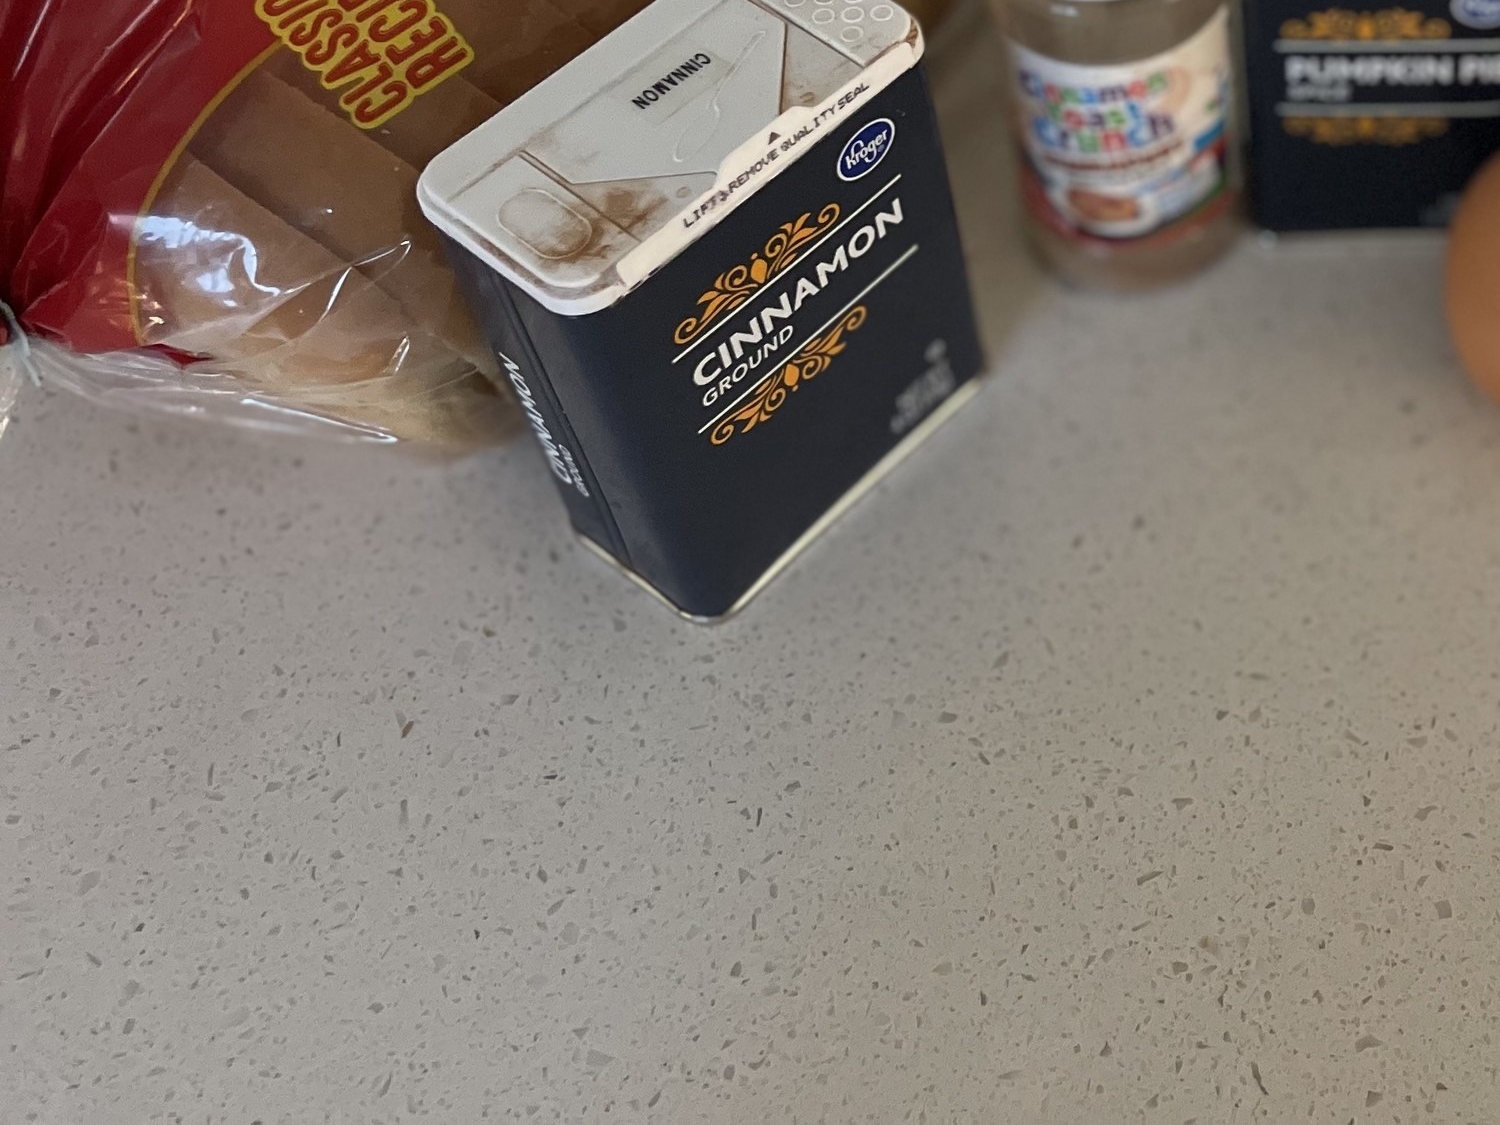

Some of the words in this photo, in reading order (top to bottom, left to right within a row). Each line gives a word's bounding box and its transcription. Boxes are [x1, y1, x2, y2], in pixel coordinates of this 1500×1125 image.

[631, 52, 711, 111] CINNAMON
[1285, 55, 1455, 86] PUMPKIN
[682, 193, 720, 228] LIFT
[728, 149, 779, 193] REMOVE
[780, 106, 836, 152] QUALITY
[837, 83, 870, 110] SEAL
[845, 128, 889, 171] Kroger
[692, 197, 904, 386] CINNAMON
[702, 325, 794, 407] GROUND
[498, 351, 574, 485] CINNAMON
[557, 442, 591, 498] GROUND
